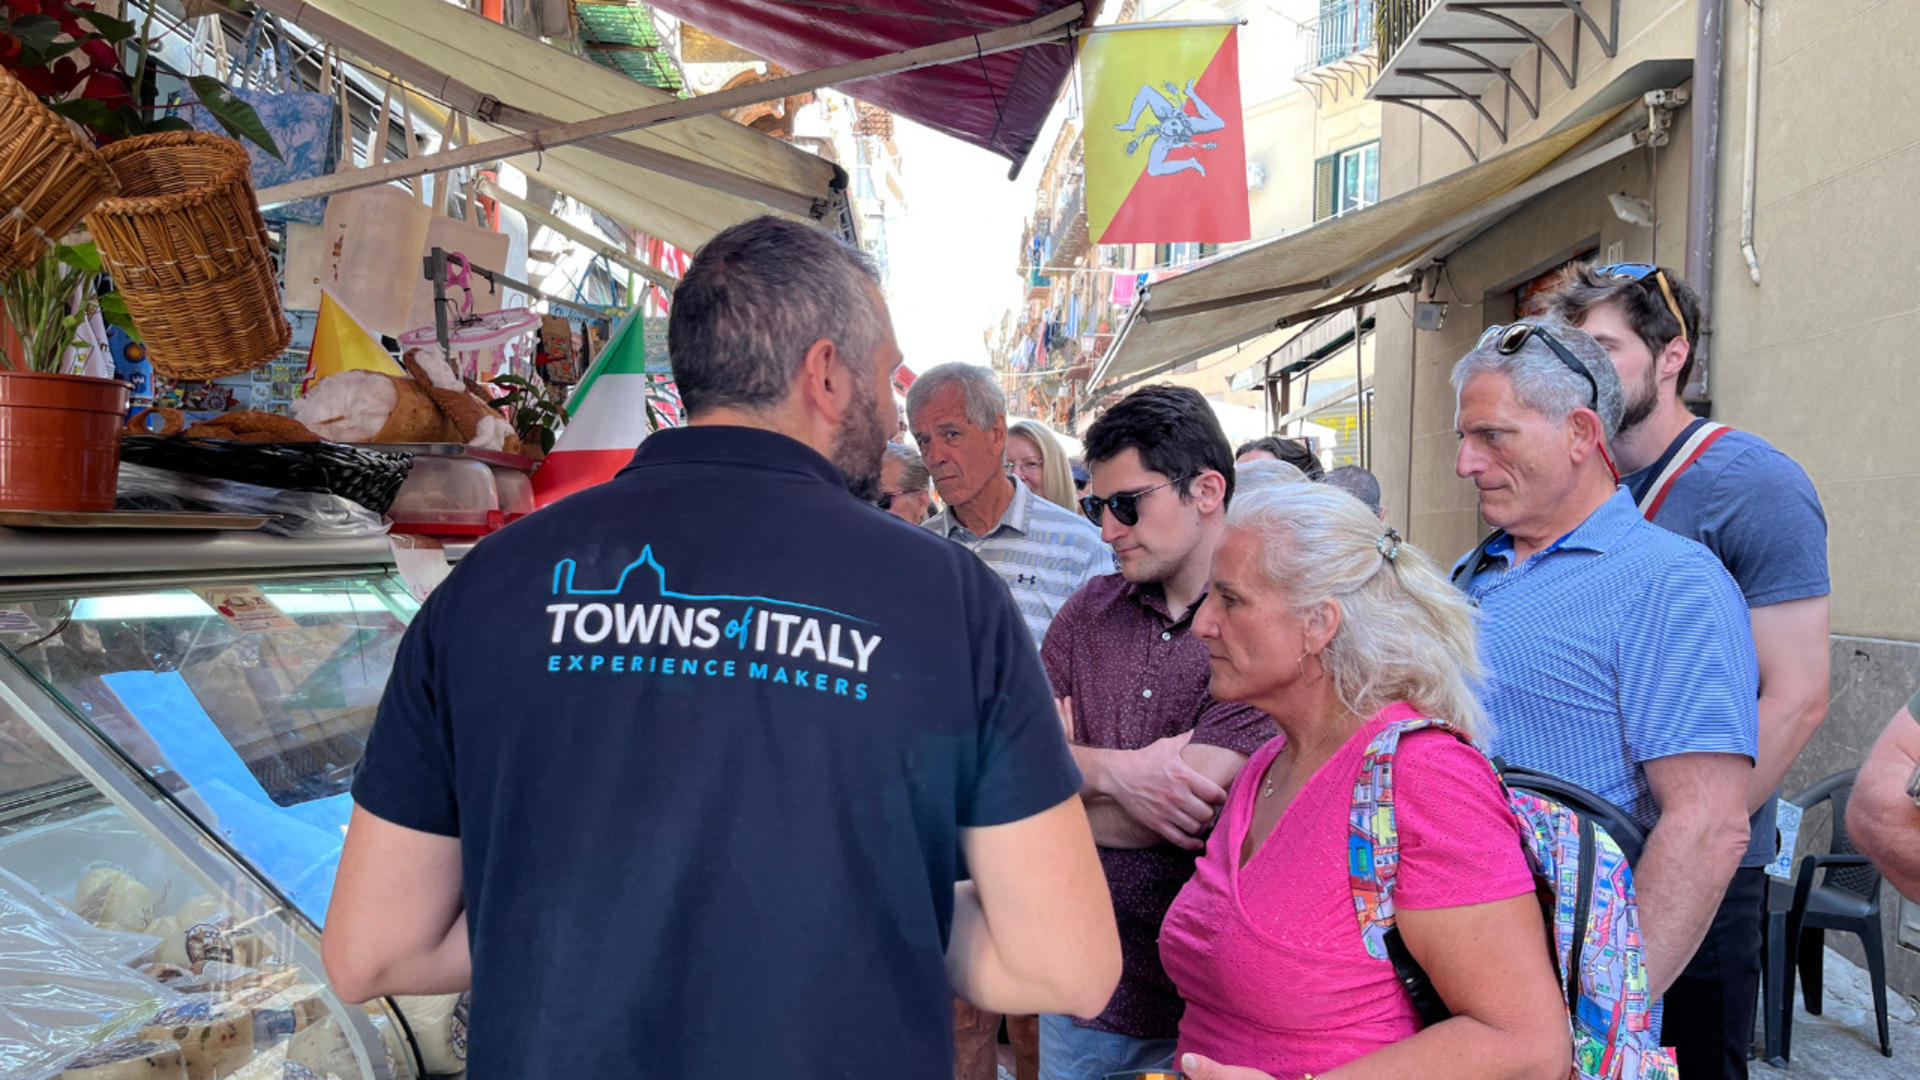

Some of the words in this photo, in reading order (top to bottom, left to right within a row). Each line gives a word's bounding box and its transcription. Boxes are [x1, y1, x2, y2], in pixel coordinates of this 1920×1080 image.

[546, 603, 720, 648] TOWNS
[724, 606, 753, 650] of
[755, 610, 882, 672] ITALY
[547, 655, 736, 677] EXPERIENCE
[749, 662, 868, 700] MAKERS
